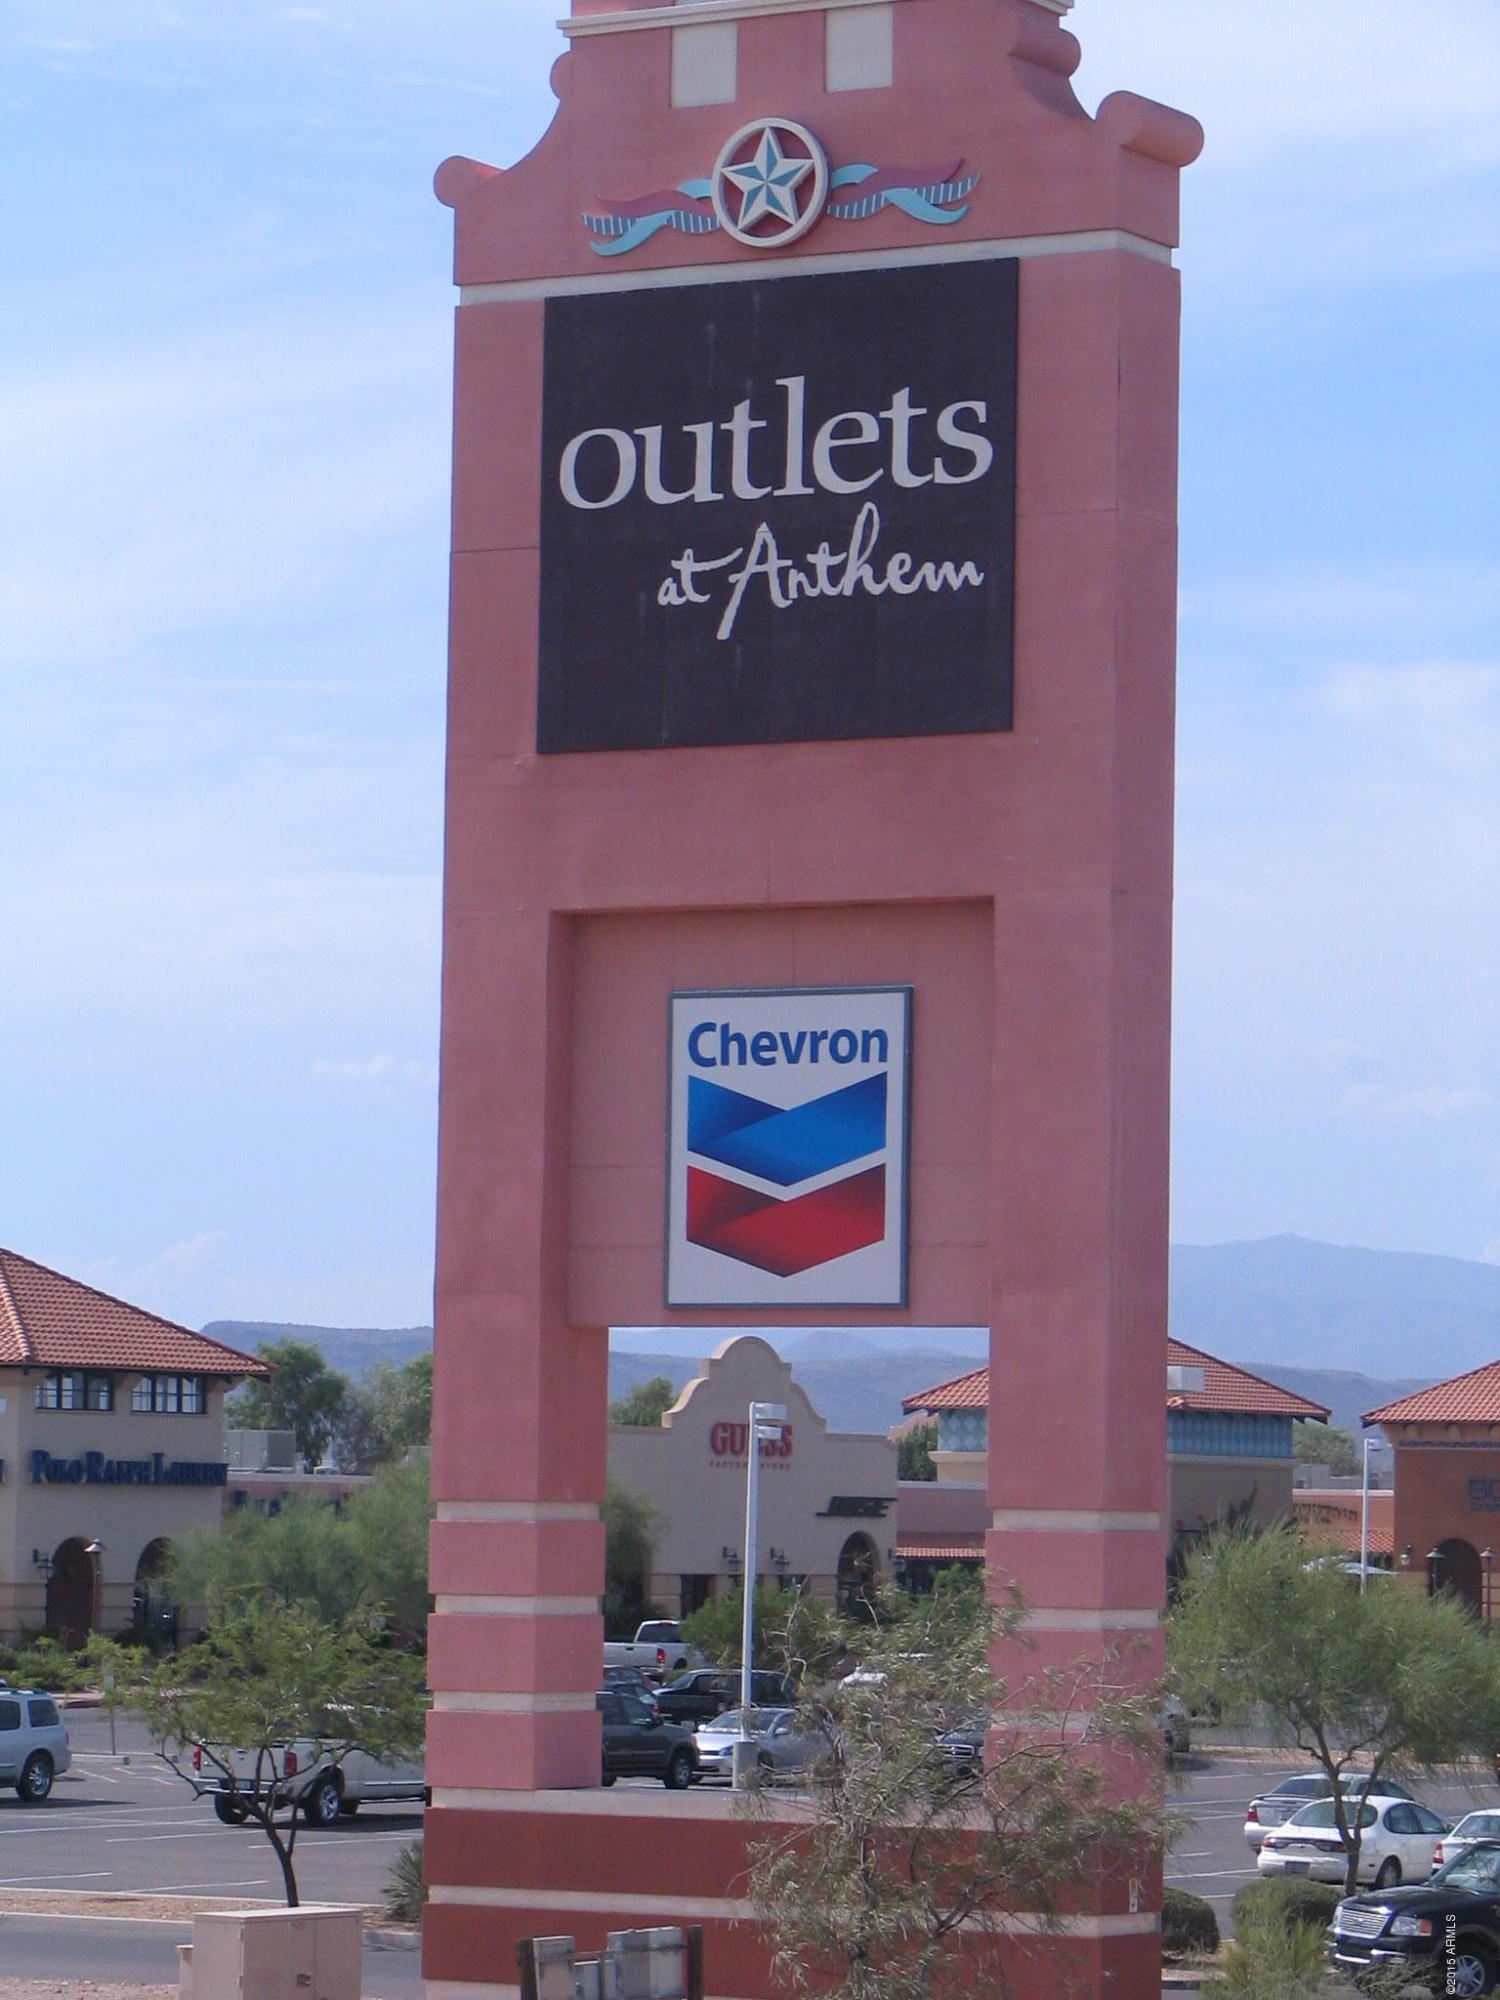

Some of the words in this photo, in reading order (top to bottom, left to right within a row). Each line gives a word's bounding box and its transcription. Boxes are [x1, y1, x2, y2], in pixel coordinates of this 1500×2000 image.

[559, 375, 994, 510] outlets
[658, 547, 743, 606] at
[717, 501, 984, 640] Anthem
[688, 1021, 889, 1068] Chevron
